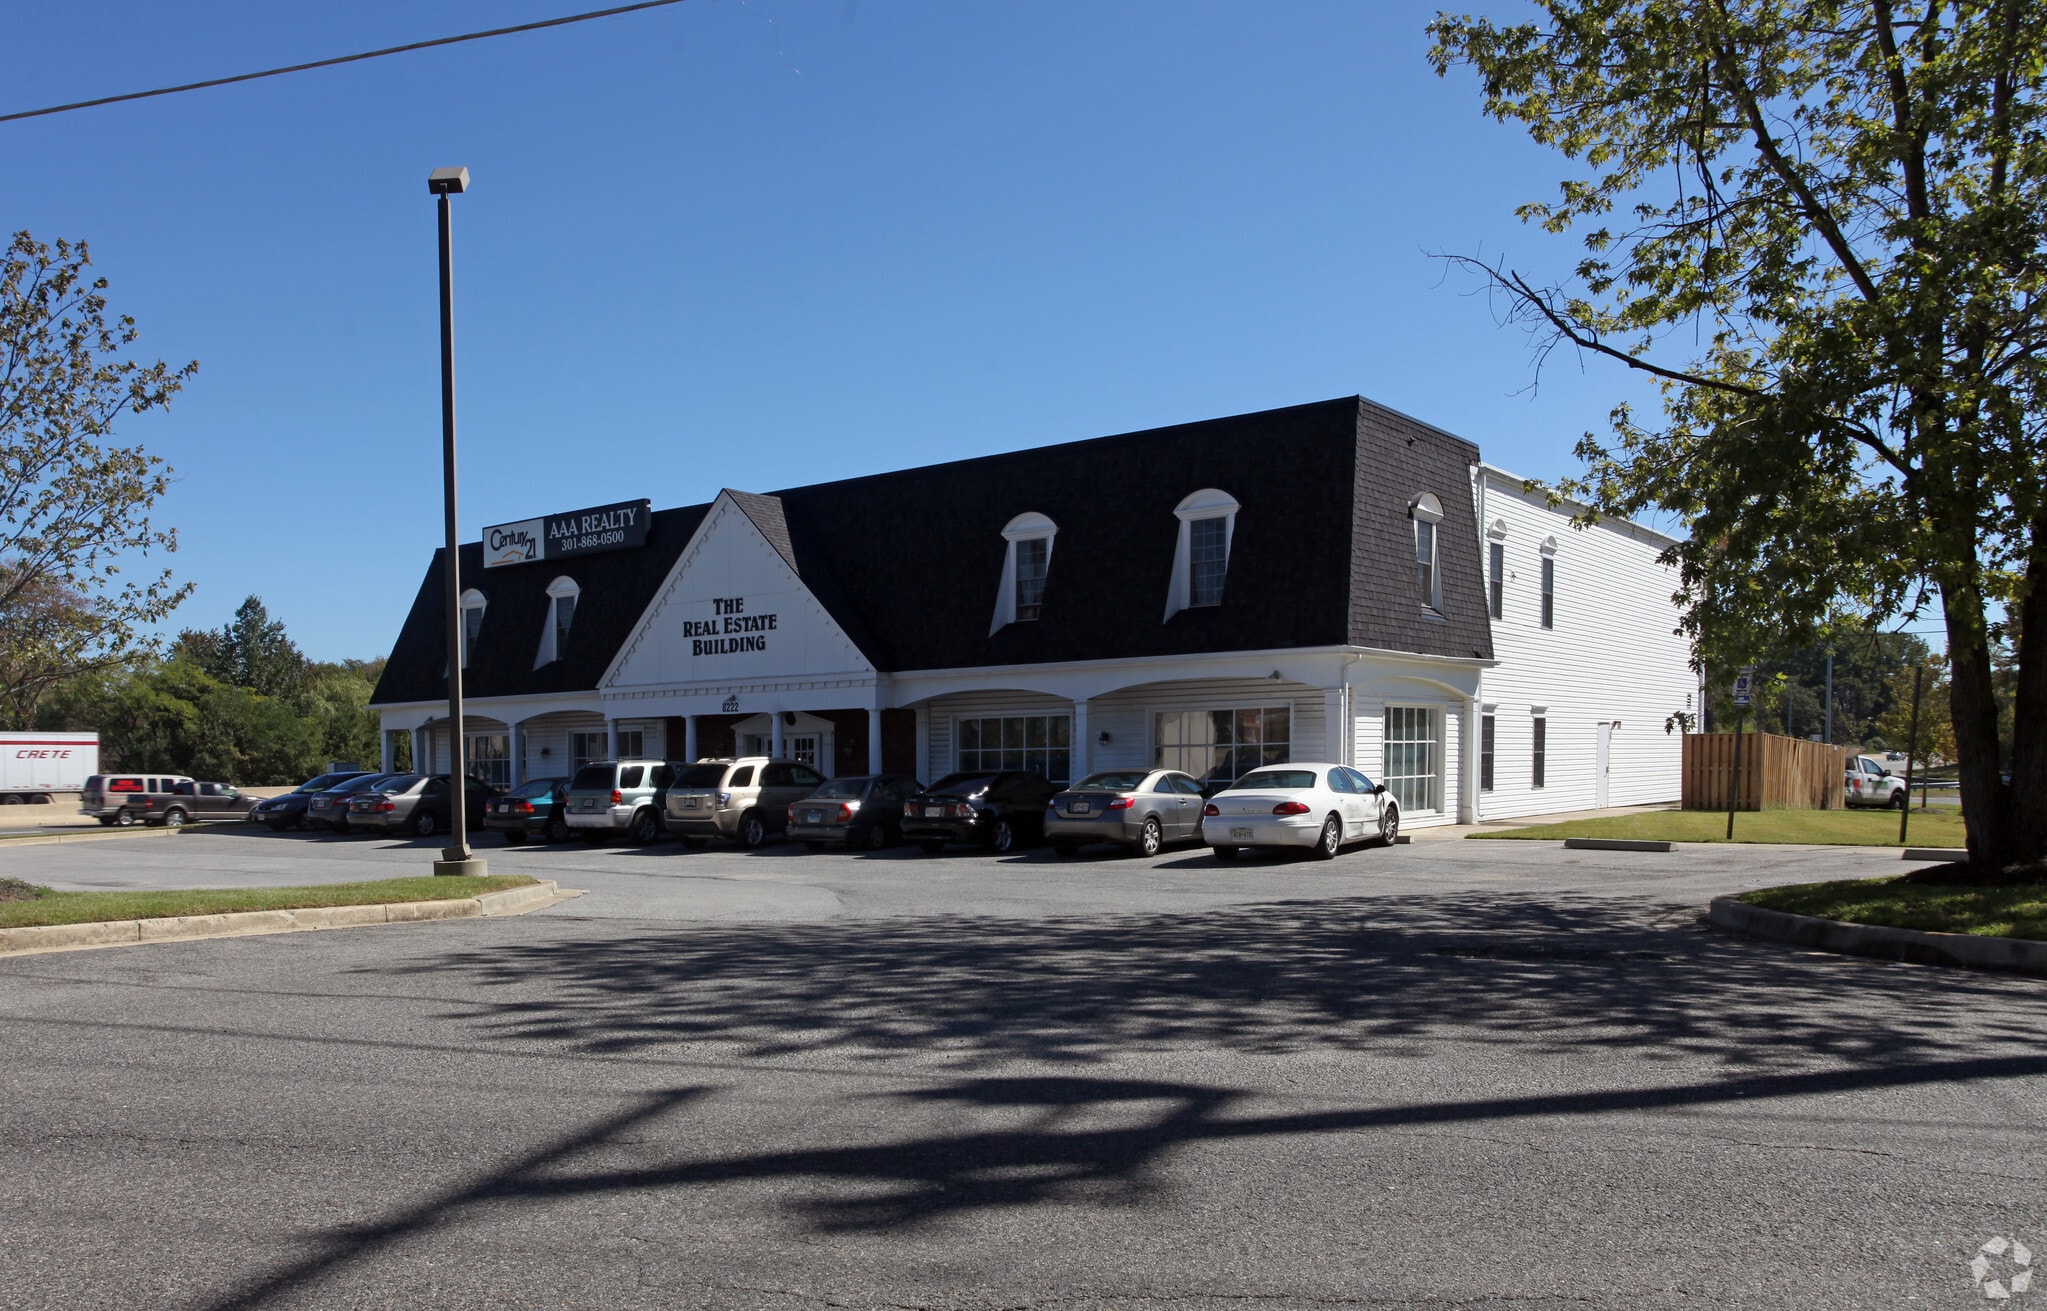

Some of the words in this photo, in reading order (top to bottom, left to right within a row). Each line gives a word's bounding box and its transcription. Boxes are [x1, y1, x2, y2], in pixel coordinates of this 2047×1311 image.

[550, 521, 579, 539] AAA
[581, 508, 637, 533] REALTY
[490, 529, 528, 551] Century
[525, 537, 536, 560] 21
[561, 530, 624, 551] 301-868-0500
[713, 598, 744, 615] THE
[683, 620, 719, 638] REAL
[723, 614, 777, 634] ESTATE
[692, 635, 766, 656] BUILDING
[16, 750, 72, 759] CRETE
